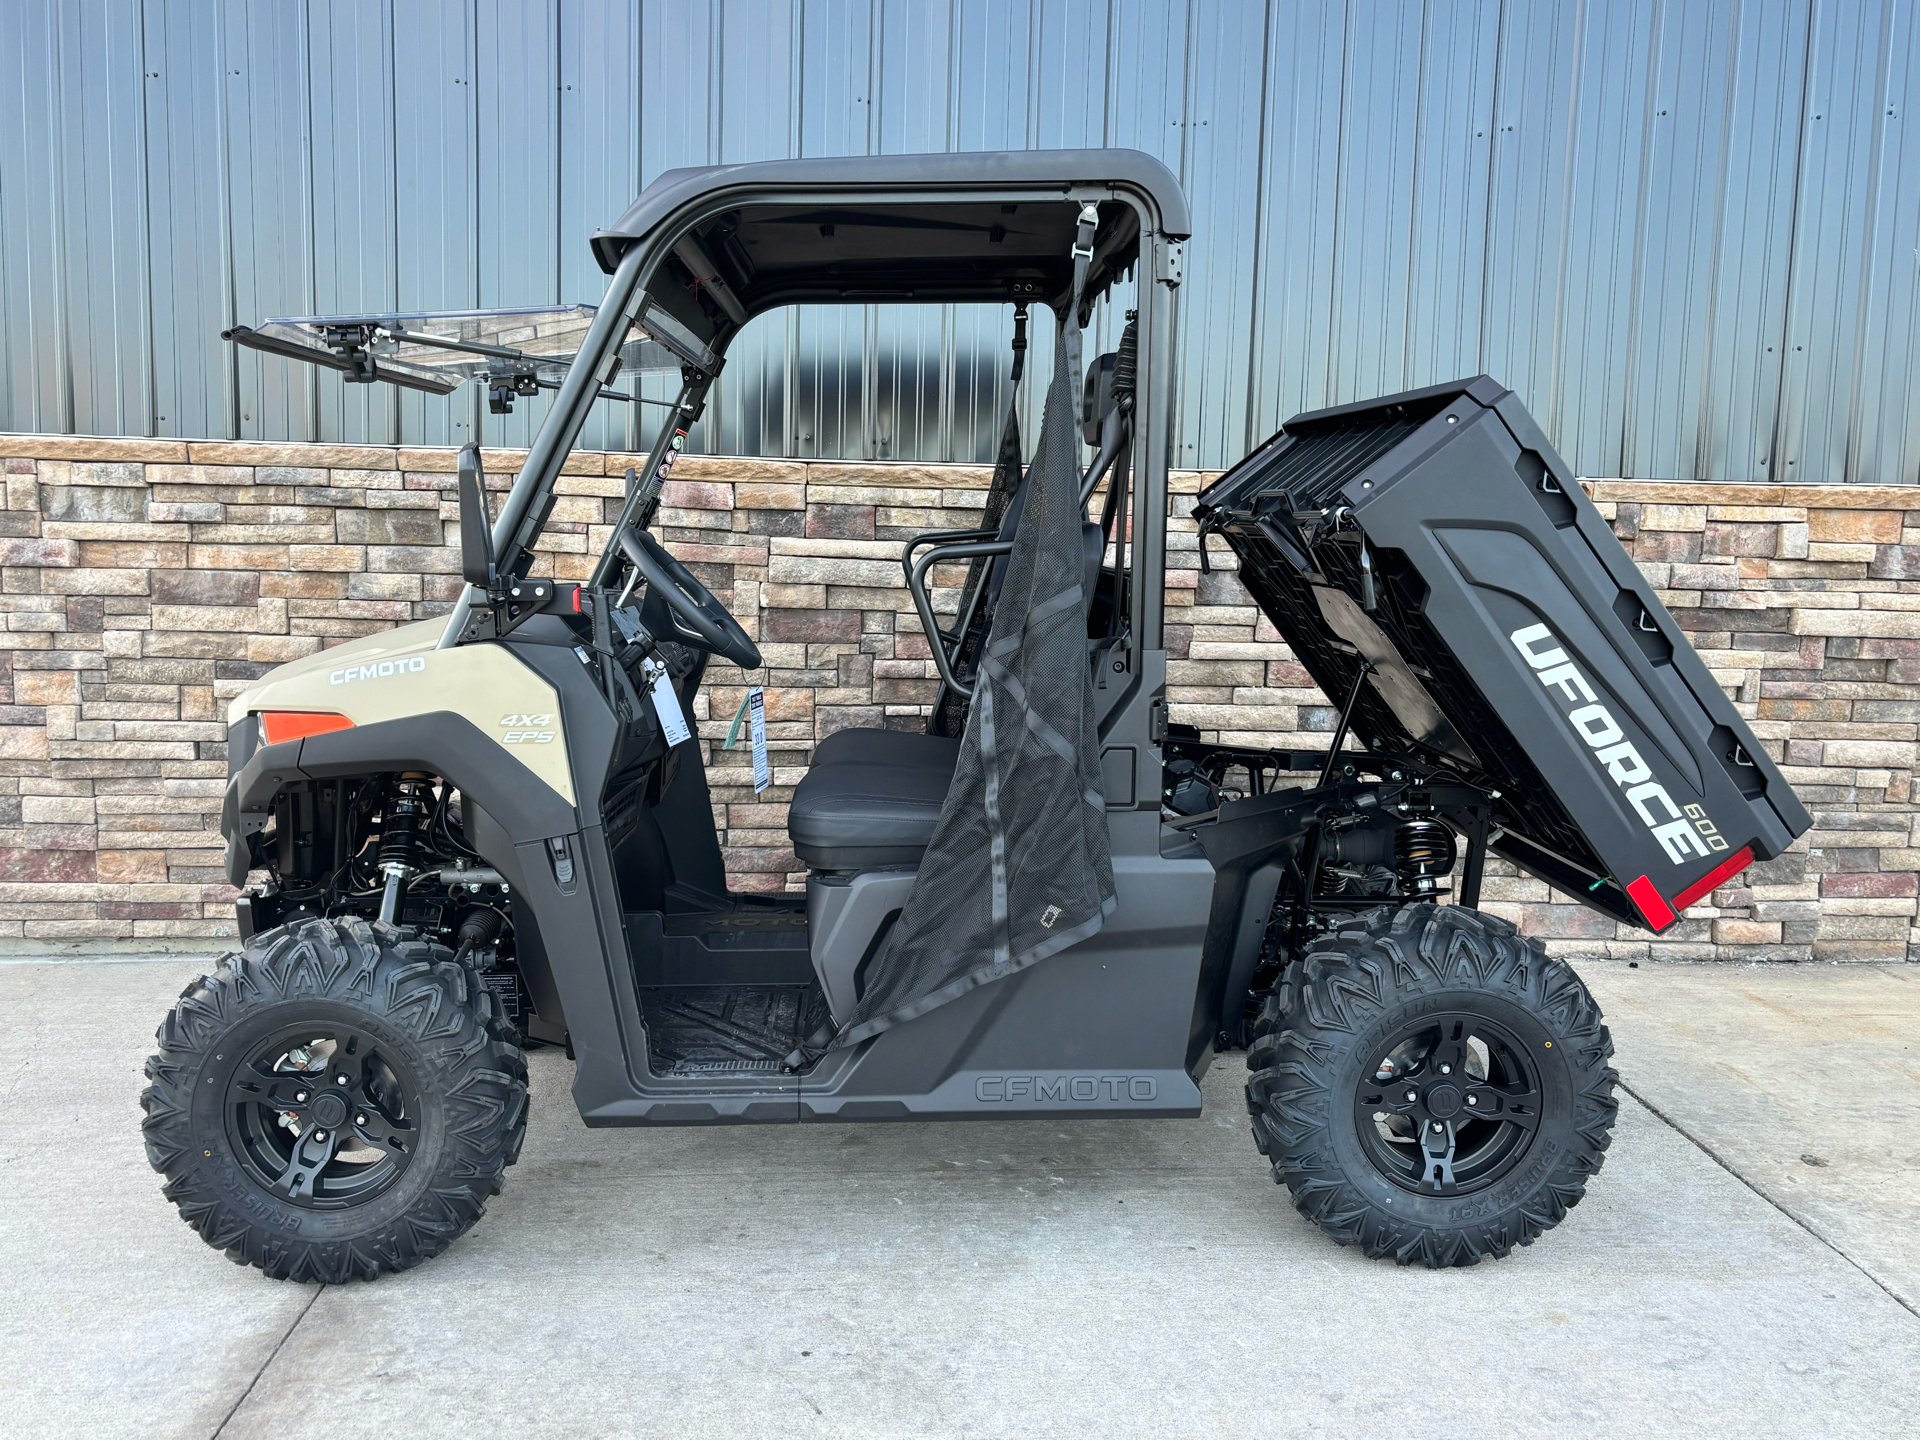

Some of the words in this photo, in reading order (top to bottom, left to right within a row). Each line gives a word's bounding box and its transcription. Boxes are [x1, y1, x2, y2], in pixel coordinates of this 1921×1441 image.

[329, 657, 426, 685] CFMOTO
[500, 714, 553, 727] 4X4
[502, 731, 556, 743] EPS
[1510, 623, 1710, 865] UFORCE
[1683, 803, 1730, 851] 600
[975, 1076, 1158, 1102] CFMOTO
[1492, 1138, 1559, 1208] BRUISER
